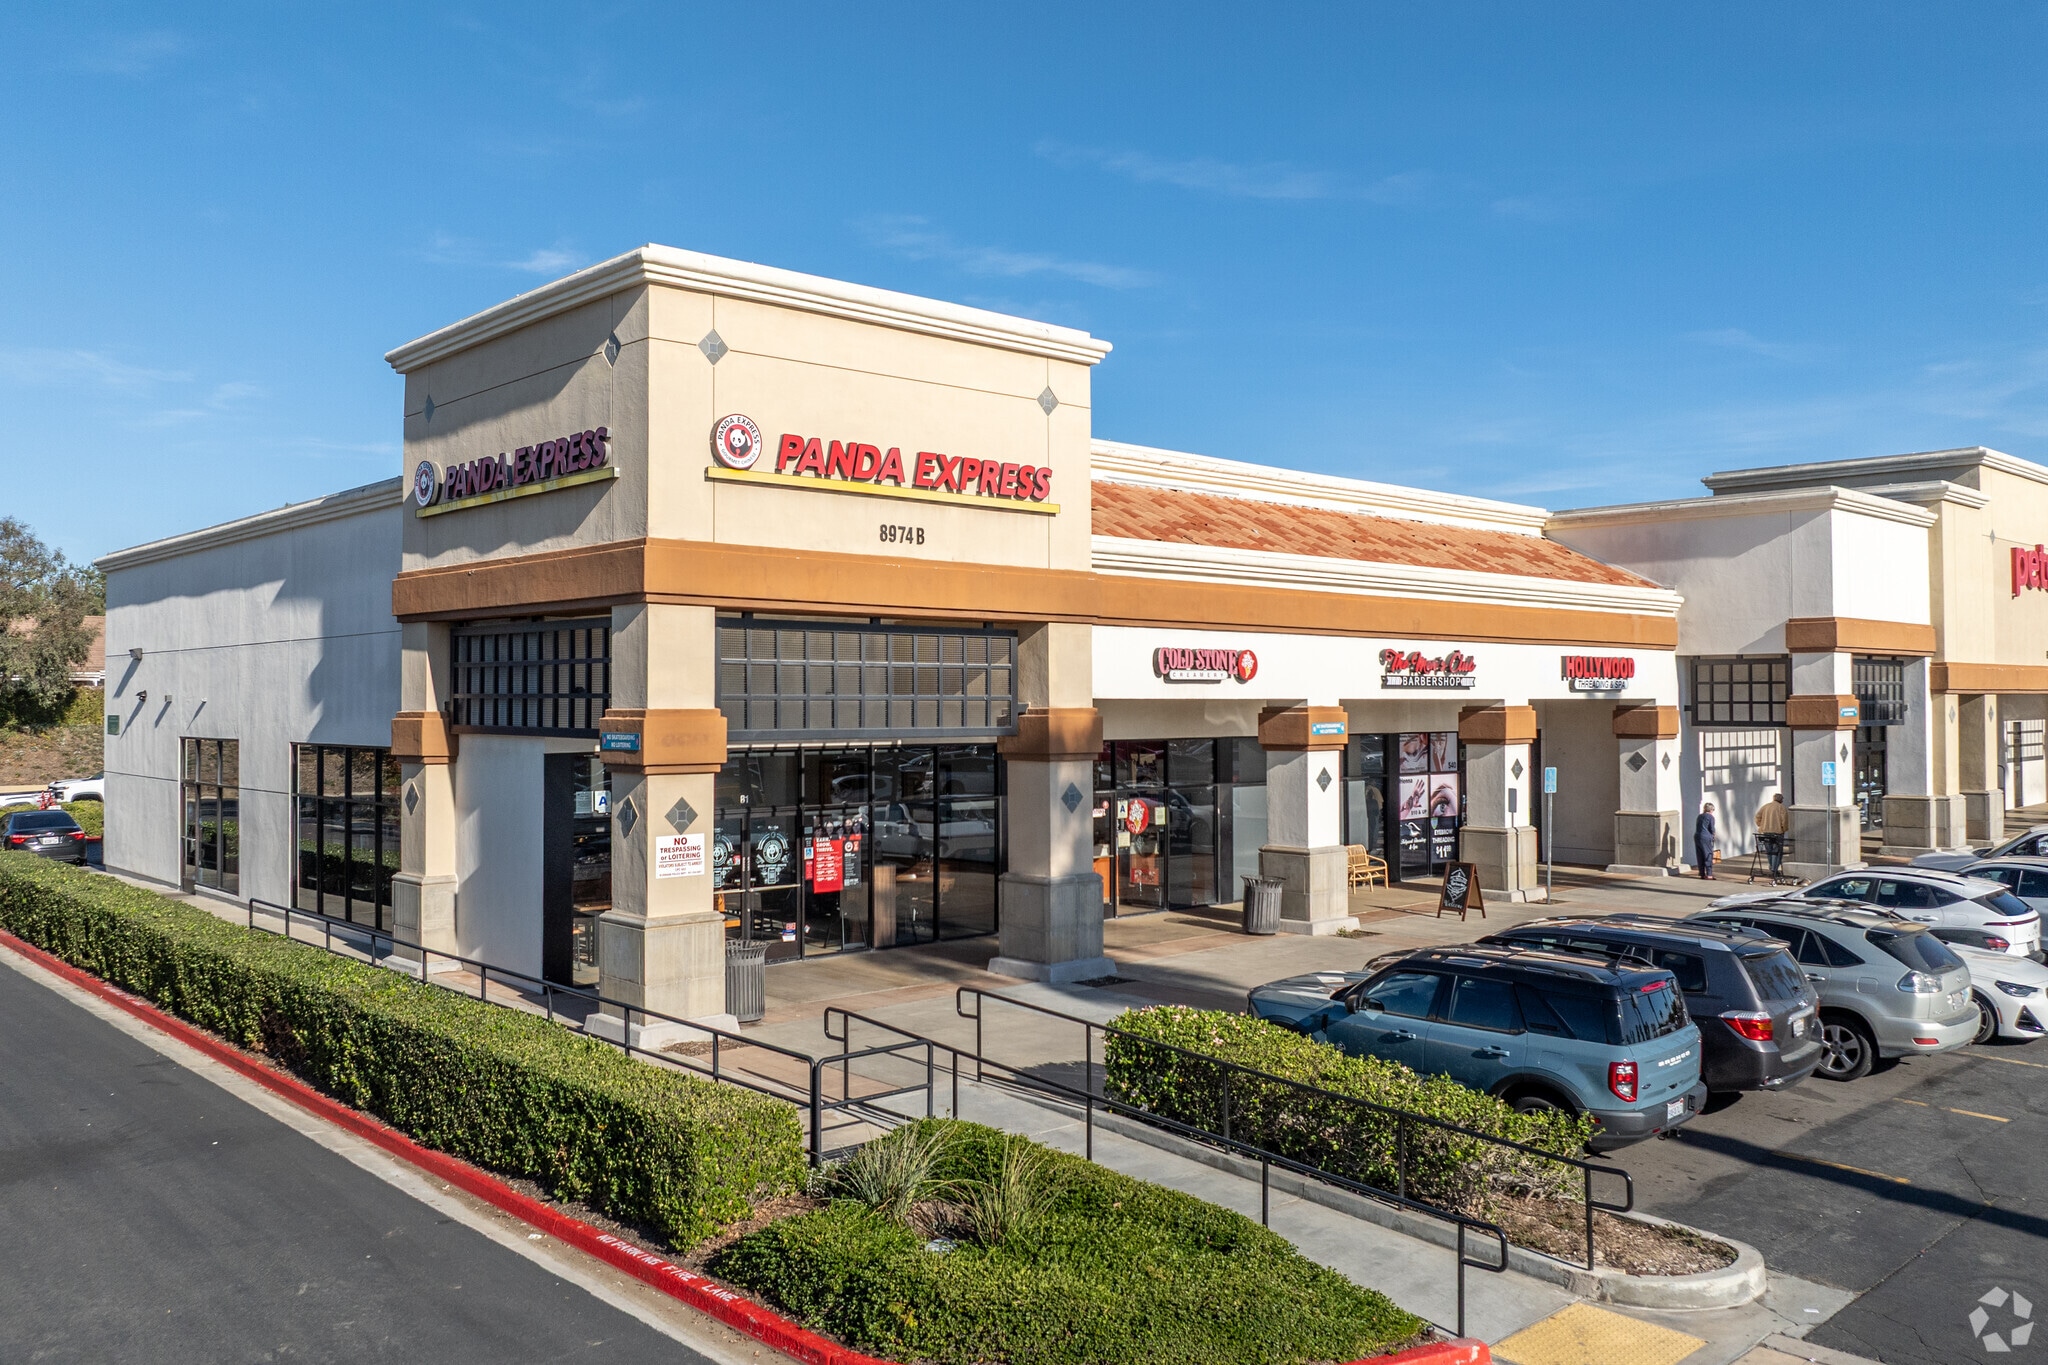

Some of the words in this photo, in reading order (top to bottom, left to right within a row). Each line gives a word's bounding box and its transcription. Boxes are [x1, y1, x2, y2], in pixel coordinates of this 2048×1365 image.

[718, 417, 735, 440] PANDA
[737, 417, 760, 444] EXPRESS
[445, 452, 509, 499] PANDA
[513, 426, 608, 484] EXPRESS
[777, 434, 906, 484] PANDA
[914, 451, 1053, 500] EXPRESS
[1158, 647, 1194, 674] COLD
[1195, 648, 1239, 675] STONE
[1565, 655, 1635, 679] HOLLYWOOD
[1402, 676, 1461, 687] BARBERSHOP
[1578, 680, 1609, 689] THREADING
[1614, 680, 1626, 689] SPA
[599, 796, 608, 806] A
[1120, 804, 1126, 813] A
[673, 837, 688, 846] NO
[1432, 836, 1455, 844] THREADING
[660, 845, 702, 854] TRESPASSING
[668, 852, 701, 860] LOITERING
[1658, 1050, 1690, 1066] BRONCO
[596, 1234, 614, 1244] NO
[611, 1240, 664, 1266] PARKING
[661, 1264, 699, 1282] FIRE
[701, 1284, 740, 1302] LANE
